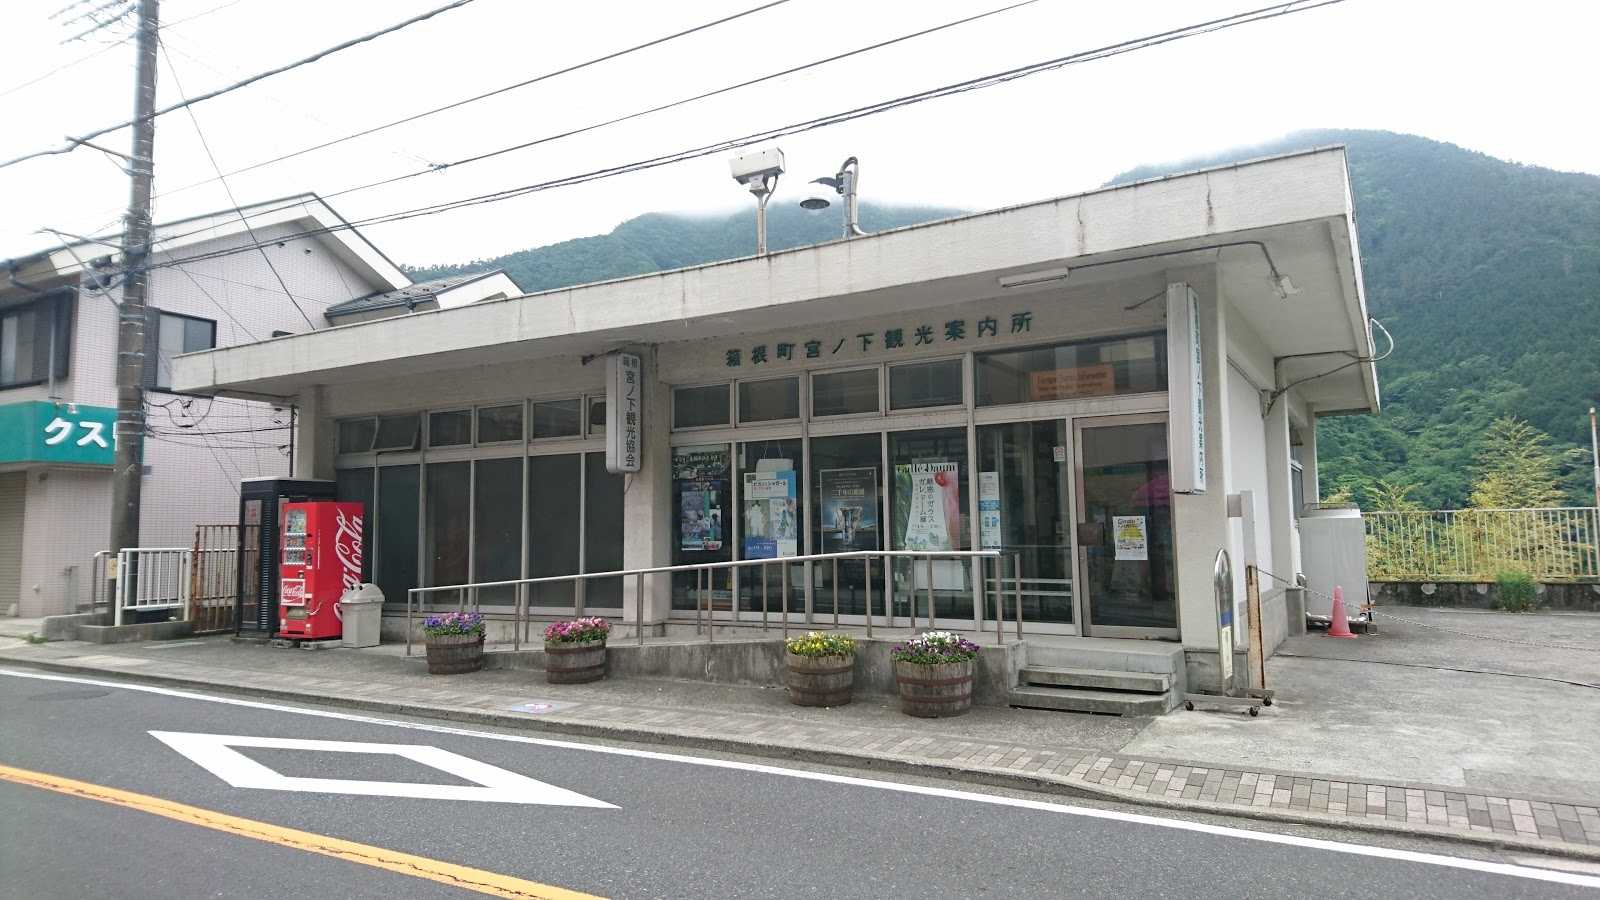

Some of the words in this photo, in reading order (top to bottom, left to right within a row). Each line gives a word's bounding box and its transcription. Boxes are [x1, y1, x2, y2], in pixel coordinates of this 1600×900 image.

[726, 311, 1034, 367] 箱根町宮ノ下観光案内所
[44, 417, 118, 452] クス
